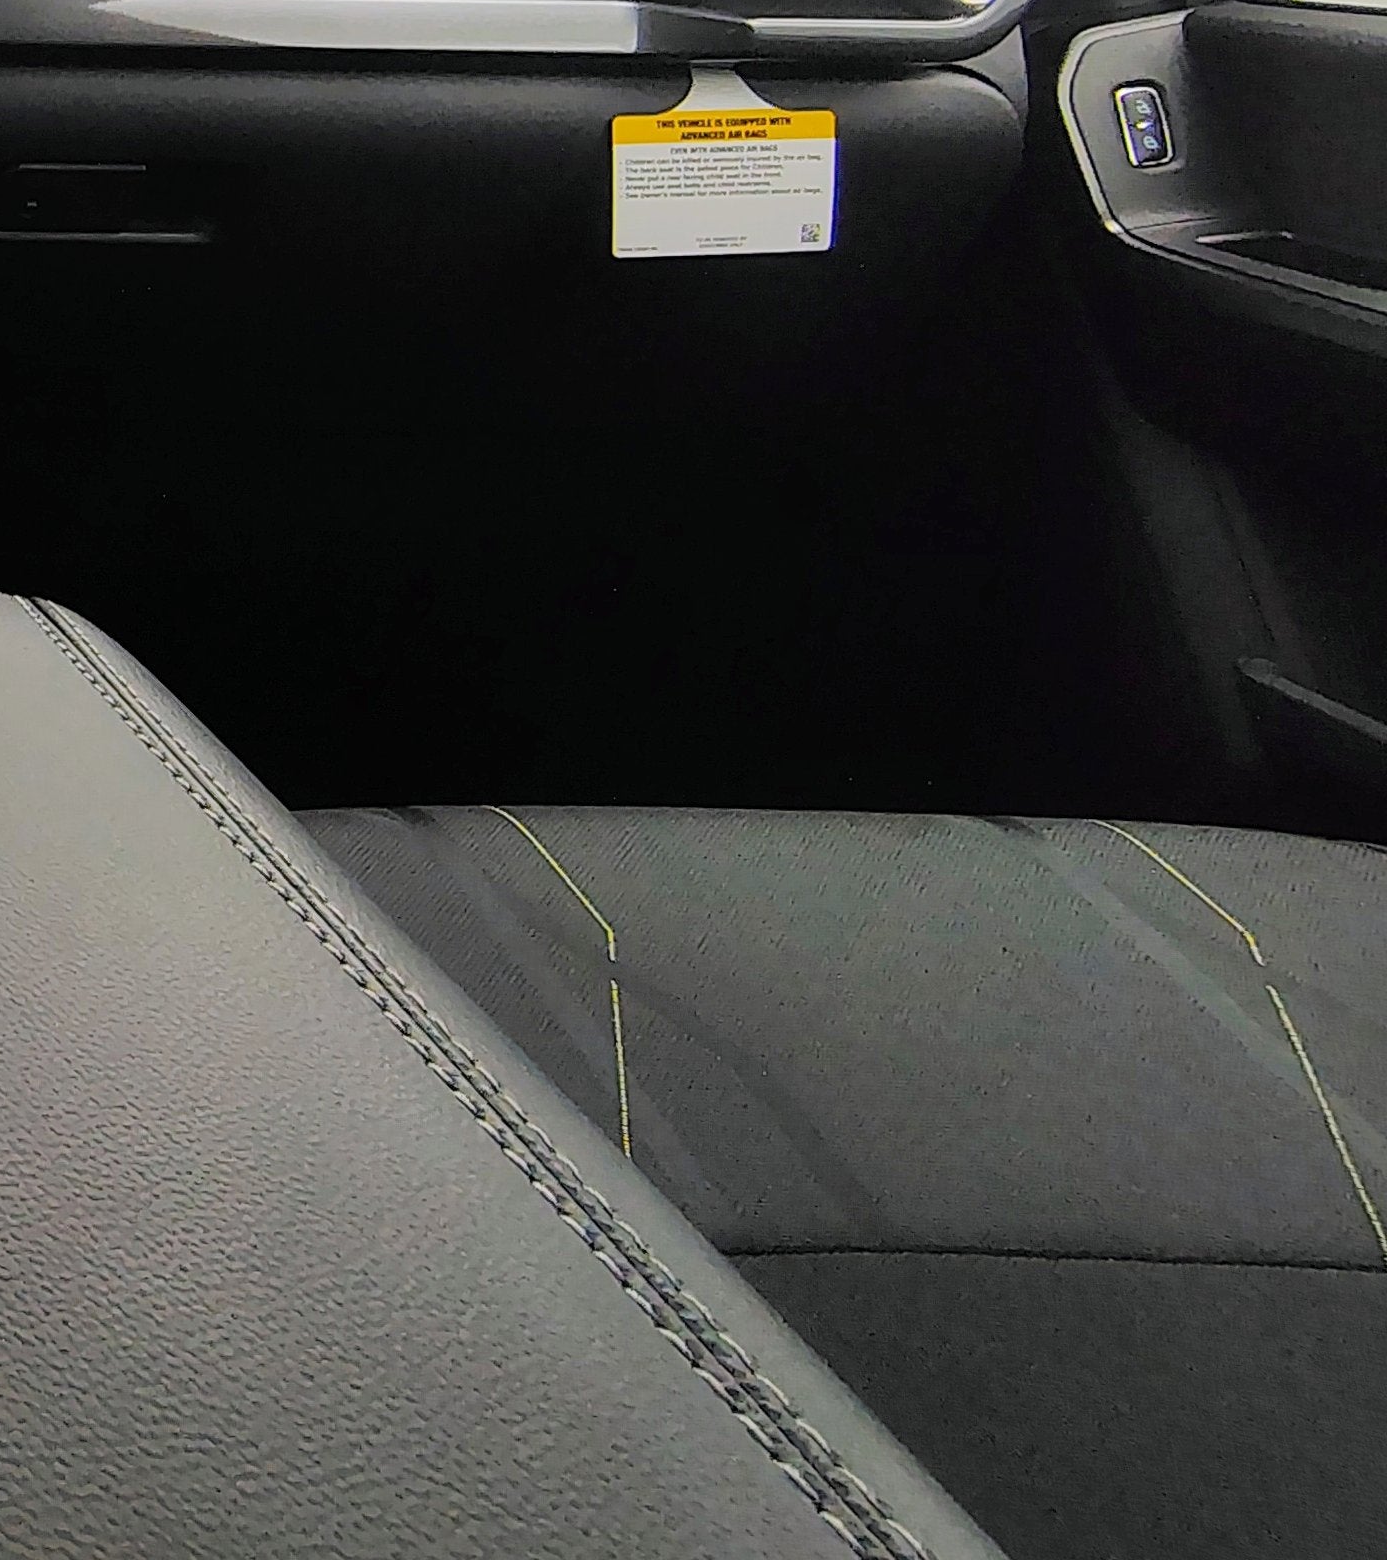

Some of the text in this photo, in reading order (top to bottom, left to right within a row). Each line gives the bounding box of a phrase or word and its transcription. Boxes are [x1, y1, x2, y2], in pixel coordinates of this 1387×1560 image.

[656, 116, 792, 129] THIS VEHICLE IS EQUIPPED WITH
[680, 129, 768, 140] ADVANCED AIR BAGS
